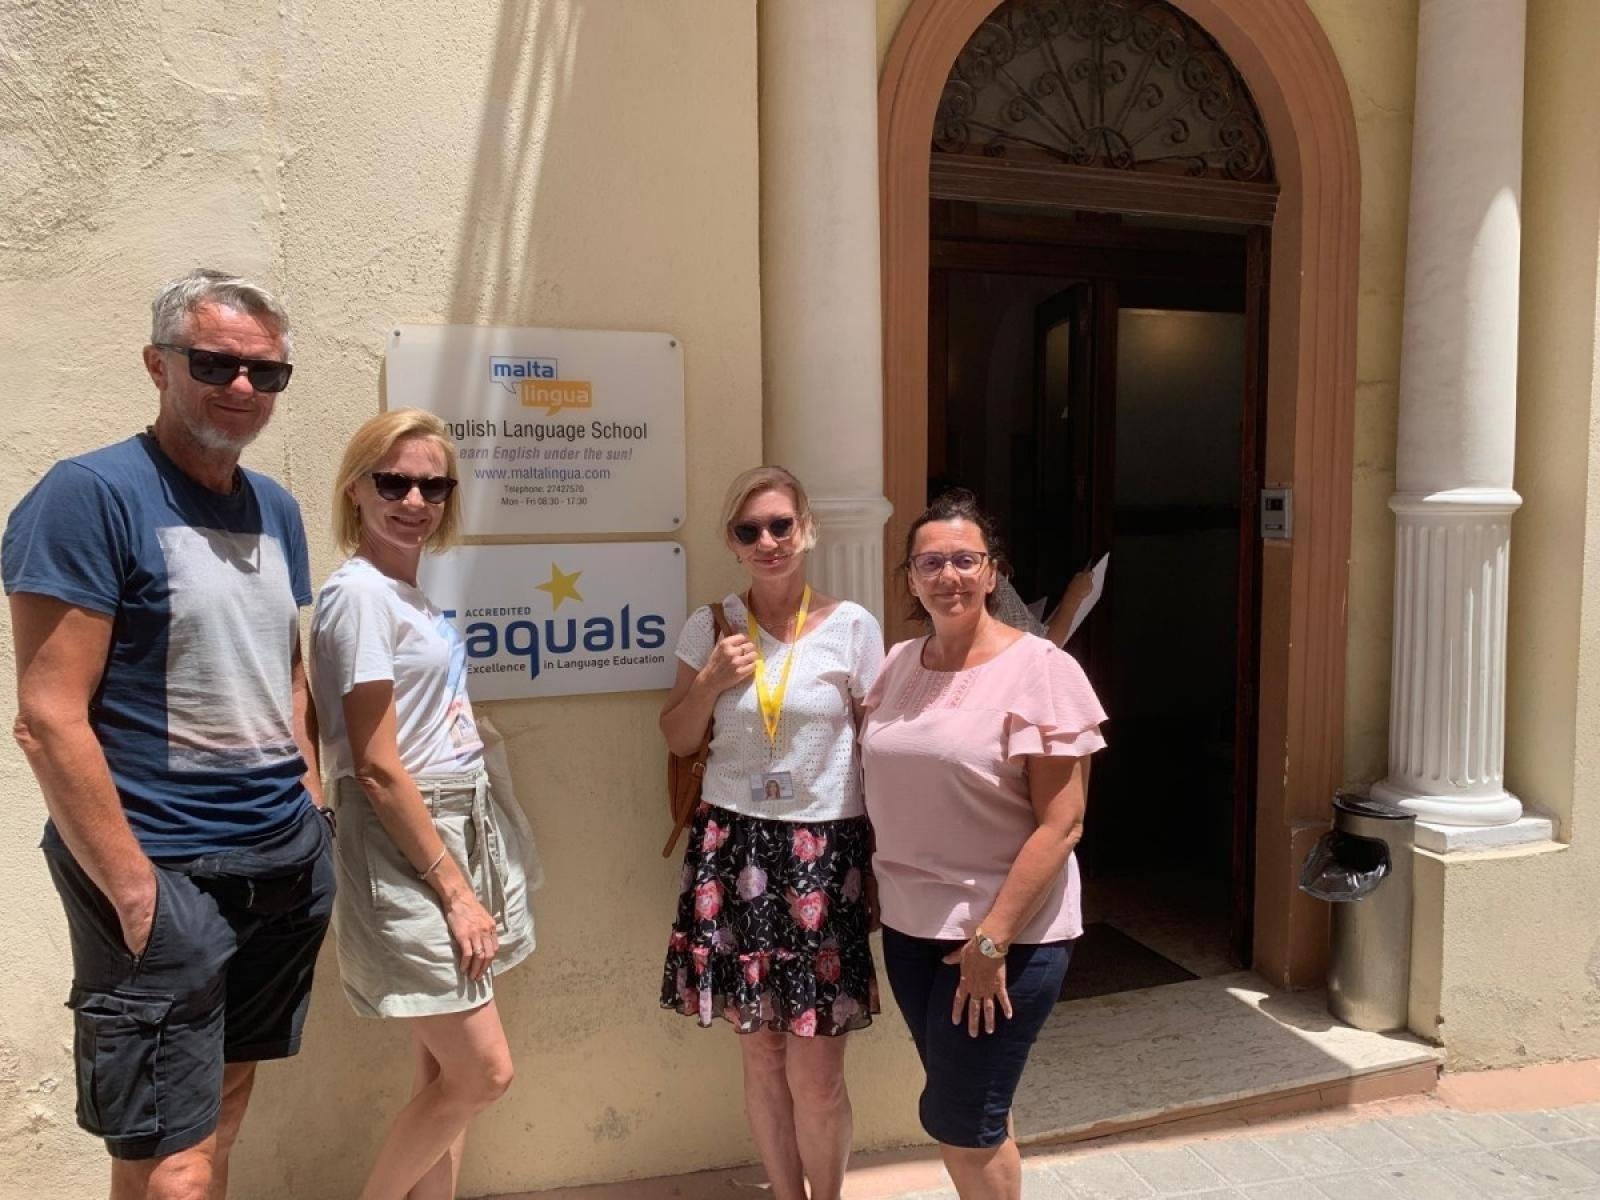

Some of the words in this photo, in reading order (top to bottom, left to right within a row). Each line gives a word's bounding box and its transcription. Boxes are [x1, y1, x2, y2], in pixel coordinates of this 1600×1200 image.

[494, 360, 554, 378] malta
[524, 384, 589, 405] lingua
[445, 419, 497, 440] nglish
[503, 420, 585, 441] Language
[591, 421, 648, 439] School
[459, 447, 489, 460] earn
[493, 445, 540, 461] English
[543, 447, 580, 460] under
[583, 447, 602, 460] the
[606, 447, 633, 461] sun!
[474, 466, 611, 481] www.maltalingua.com
[504, 484, 545, 494] Telephone:
[500, 497, 519, 505] Mon
[464, 606, 532, 618] ACCREDITED
[442, 603, 665, 680] aquals
[466, 662, 527, 675] Excellence
[543, 659, 554, 670] in
[557, 657, 611, 670] Language
[612, 654, 666, 666] Education
